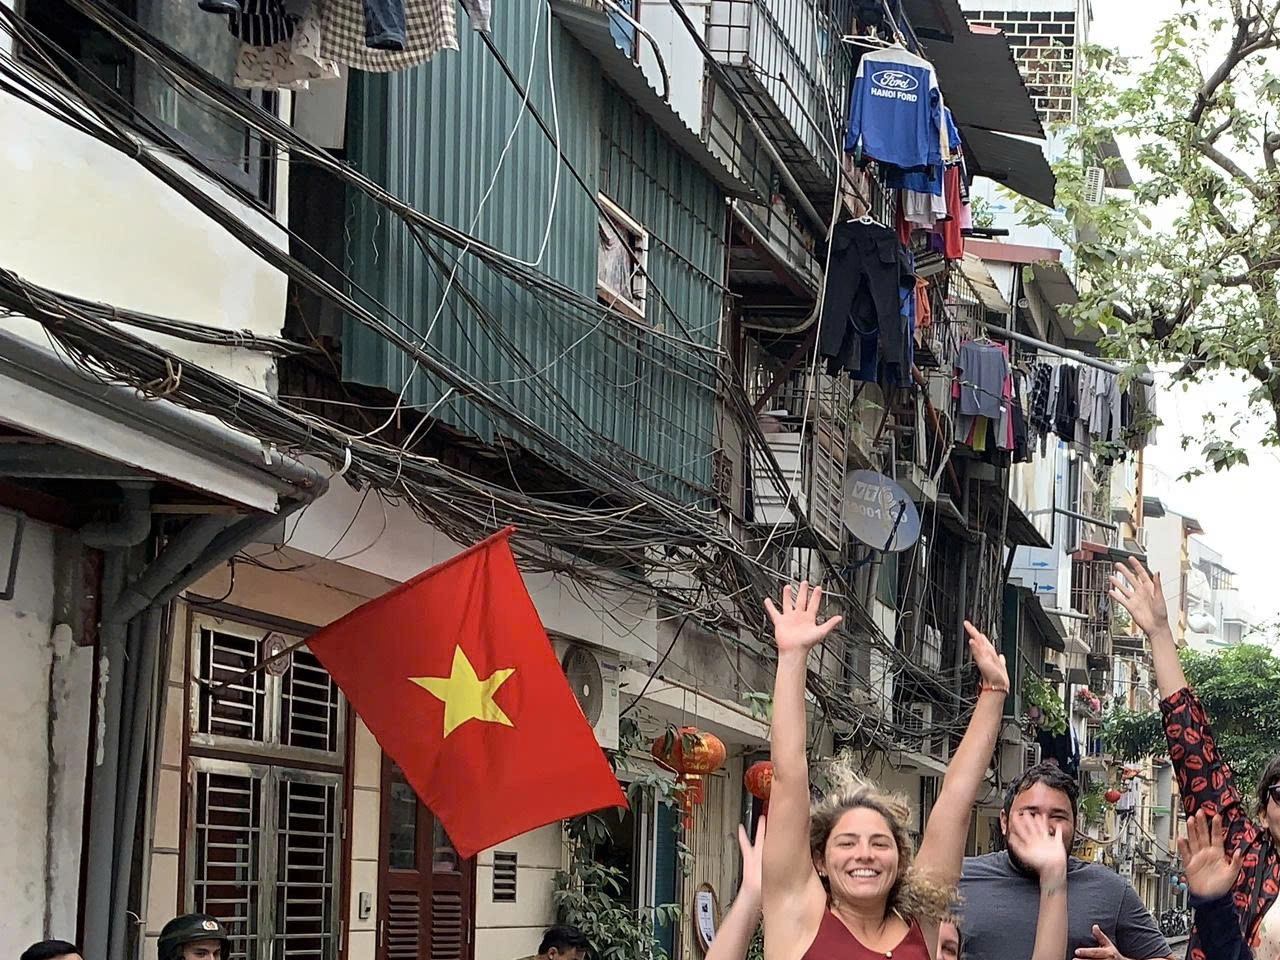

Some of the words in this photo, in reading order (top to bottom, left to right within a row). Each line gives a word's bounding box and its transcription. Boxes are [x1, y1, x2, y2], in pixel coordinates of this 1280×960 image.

[880, 72, 910, 88] Ford
[871, 87, 896, 98] HANOI
[897, 91, 918, 102] FORD
